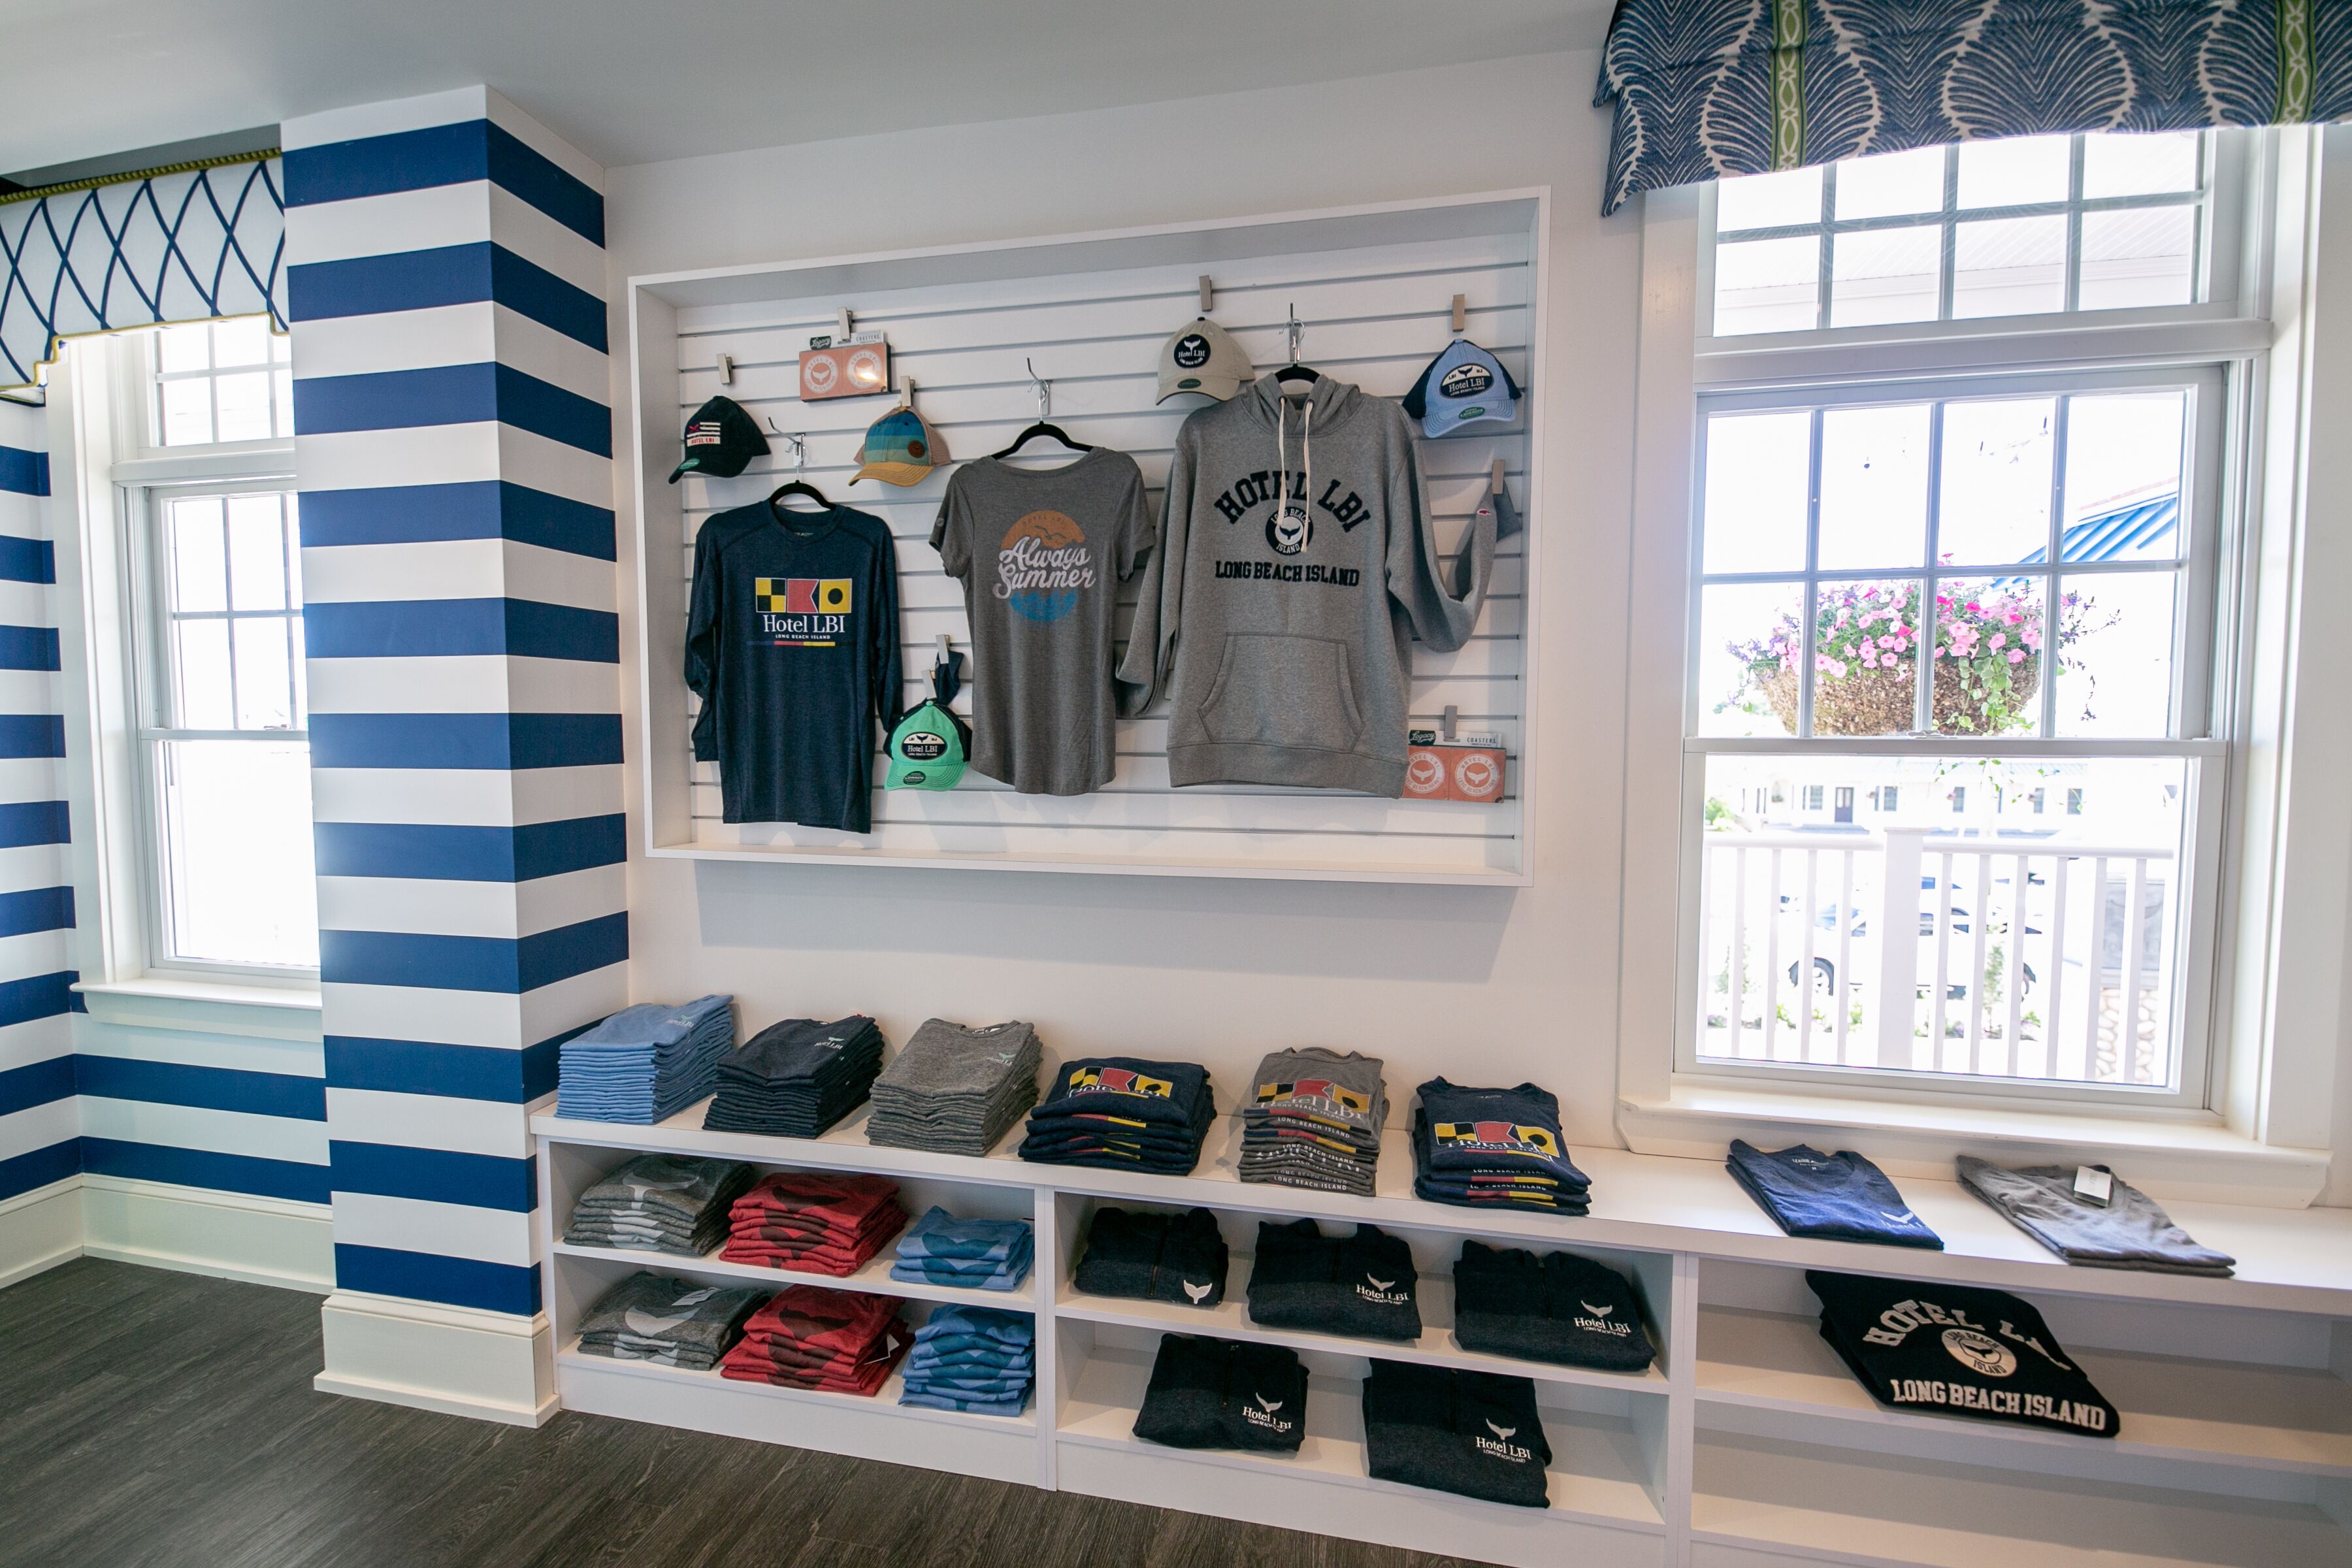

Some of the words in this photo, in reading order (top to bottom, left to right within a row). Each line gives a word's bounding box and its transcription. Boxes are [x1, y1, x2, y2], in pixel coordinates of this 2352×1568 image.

[1448, 380, 1469, 392] Hotel
[1470, 378, 1485, 387] LBI
[1317, 479, 1371, 533] LBI
[1271, 510, 1288, 524] LOG
[999, 536, 1091, 571] Always
[1276, 543, 1300, 553] ISLAND
[992, 563, 1096, 599] Summer
[1215, 561, 1252, 579] LONG
[1254, 562, 1302, 582] BEACH
[1305, 564, 1360, 587] ISLAND
[763, 615, 808, 632] Hotel
[812, 615, 845, 633] LBI
[1409, 730, 1435, 743] Legacy
[1409, 754, 1427, 763] OTEL
[1460, 757, 1481, 769] HOTEL
[1295, 1103, 1318, 1112] BEACH
[1320, 1110, 1345, 1120] ISLAND
[1299, 1120, 1322, 1130] BEACH
[1324, 1126, 1350, 1139] ISLAND
[1304, 1145, 1326, 1157] BEACH
[1328, 1153, 1354, 1164] ISLAND
[1296, 1179, 1318, 1188] BEACH
[1356, 1284, 1384, 1299] Hotel
[1388, 1292, 1410, 1301] LBI
[1573, 1317, 1606, 1330] Hotel
[1607, 1320, 1631, 1333] LBI
[1863, 1299, 1986, 1347] HOTEL
[1965, 1332, 2000, 1348] BEACH
[1973, 1360, 2007, 1374] ISLAND
[1891, 1379, 1947, 1404] LONG
[1948, 1382, 2021, 1415] BEACH
[2023, 1392, 2106, 1431] ISLAND
[1242, 1406, 1271, 1422] Hotel
[1273, 1417, 1292, 1429] LBI
[1475, 1436, 1507, 1454] Hotel
[1509, 1444, 1532, 1460] LBI
[1496, 1451, 1510, 1460] BEACH
